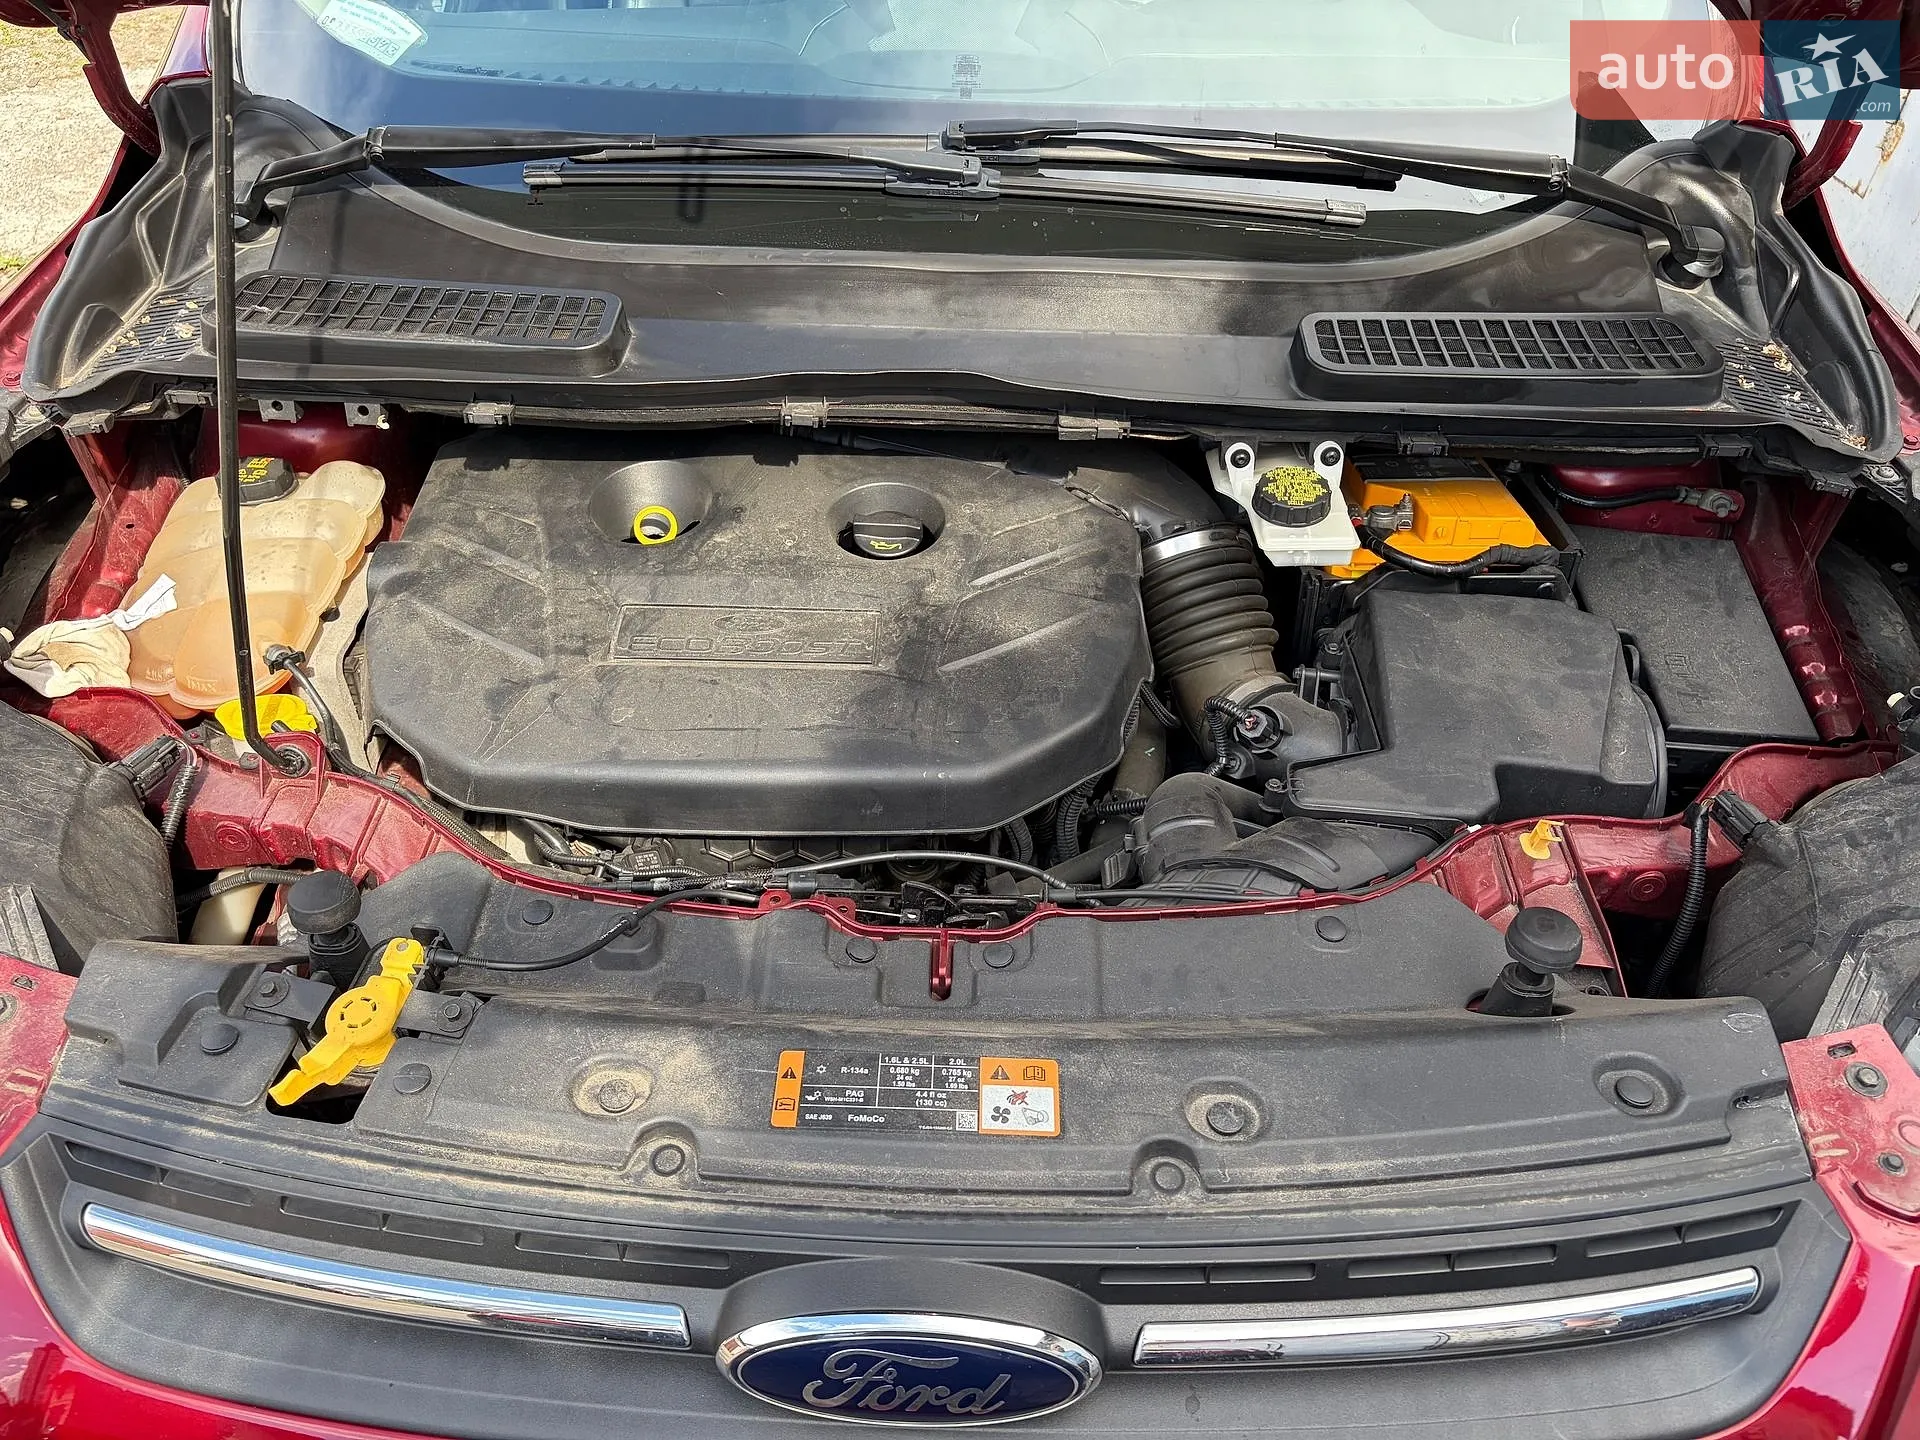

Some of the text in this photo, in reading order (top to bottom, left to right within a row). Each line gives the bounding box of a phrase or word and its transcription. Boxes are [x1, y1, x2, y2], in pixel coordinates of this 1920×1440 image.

[884, 1056, 929, 1065] 1.6L & 2.5L
[949, 1058, 967, 1066] 2.0L
[840, 1066, 869, 1075] R-134a
[910, 1067, 920, 1076] kg
[962, 1069, 972, 1078] kg
[845, 1089, 865, 1098] PAG
[915, 1099, 947, 1108] (130 cc)
[847, 1114, 886, 1123] FoMoCo
[802, 1348, 1011, 1415] Ford
